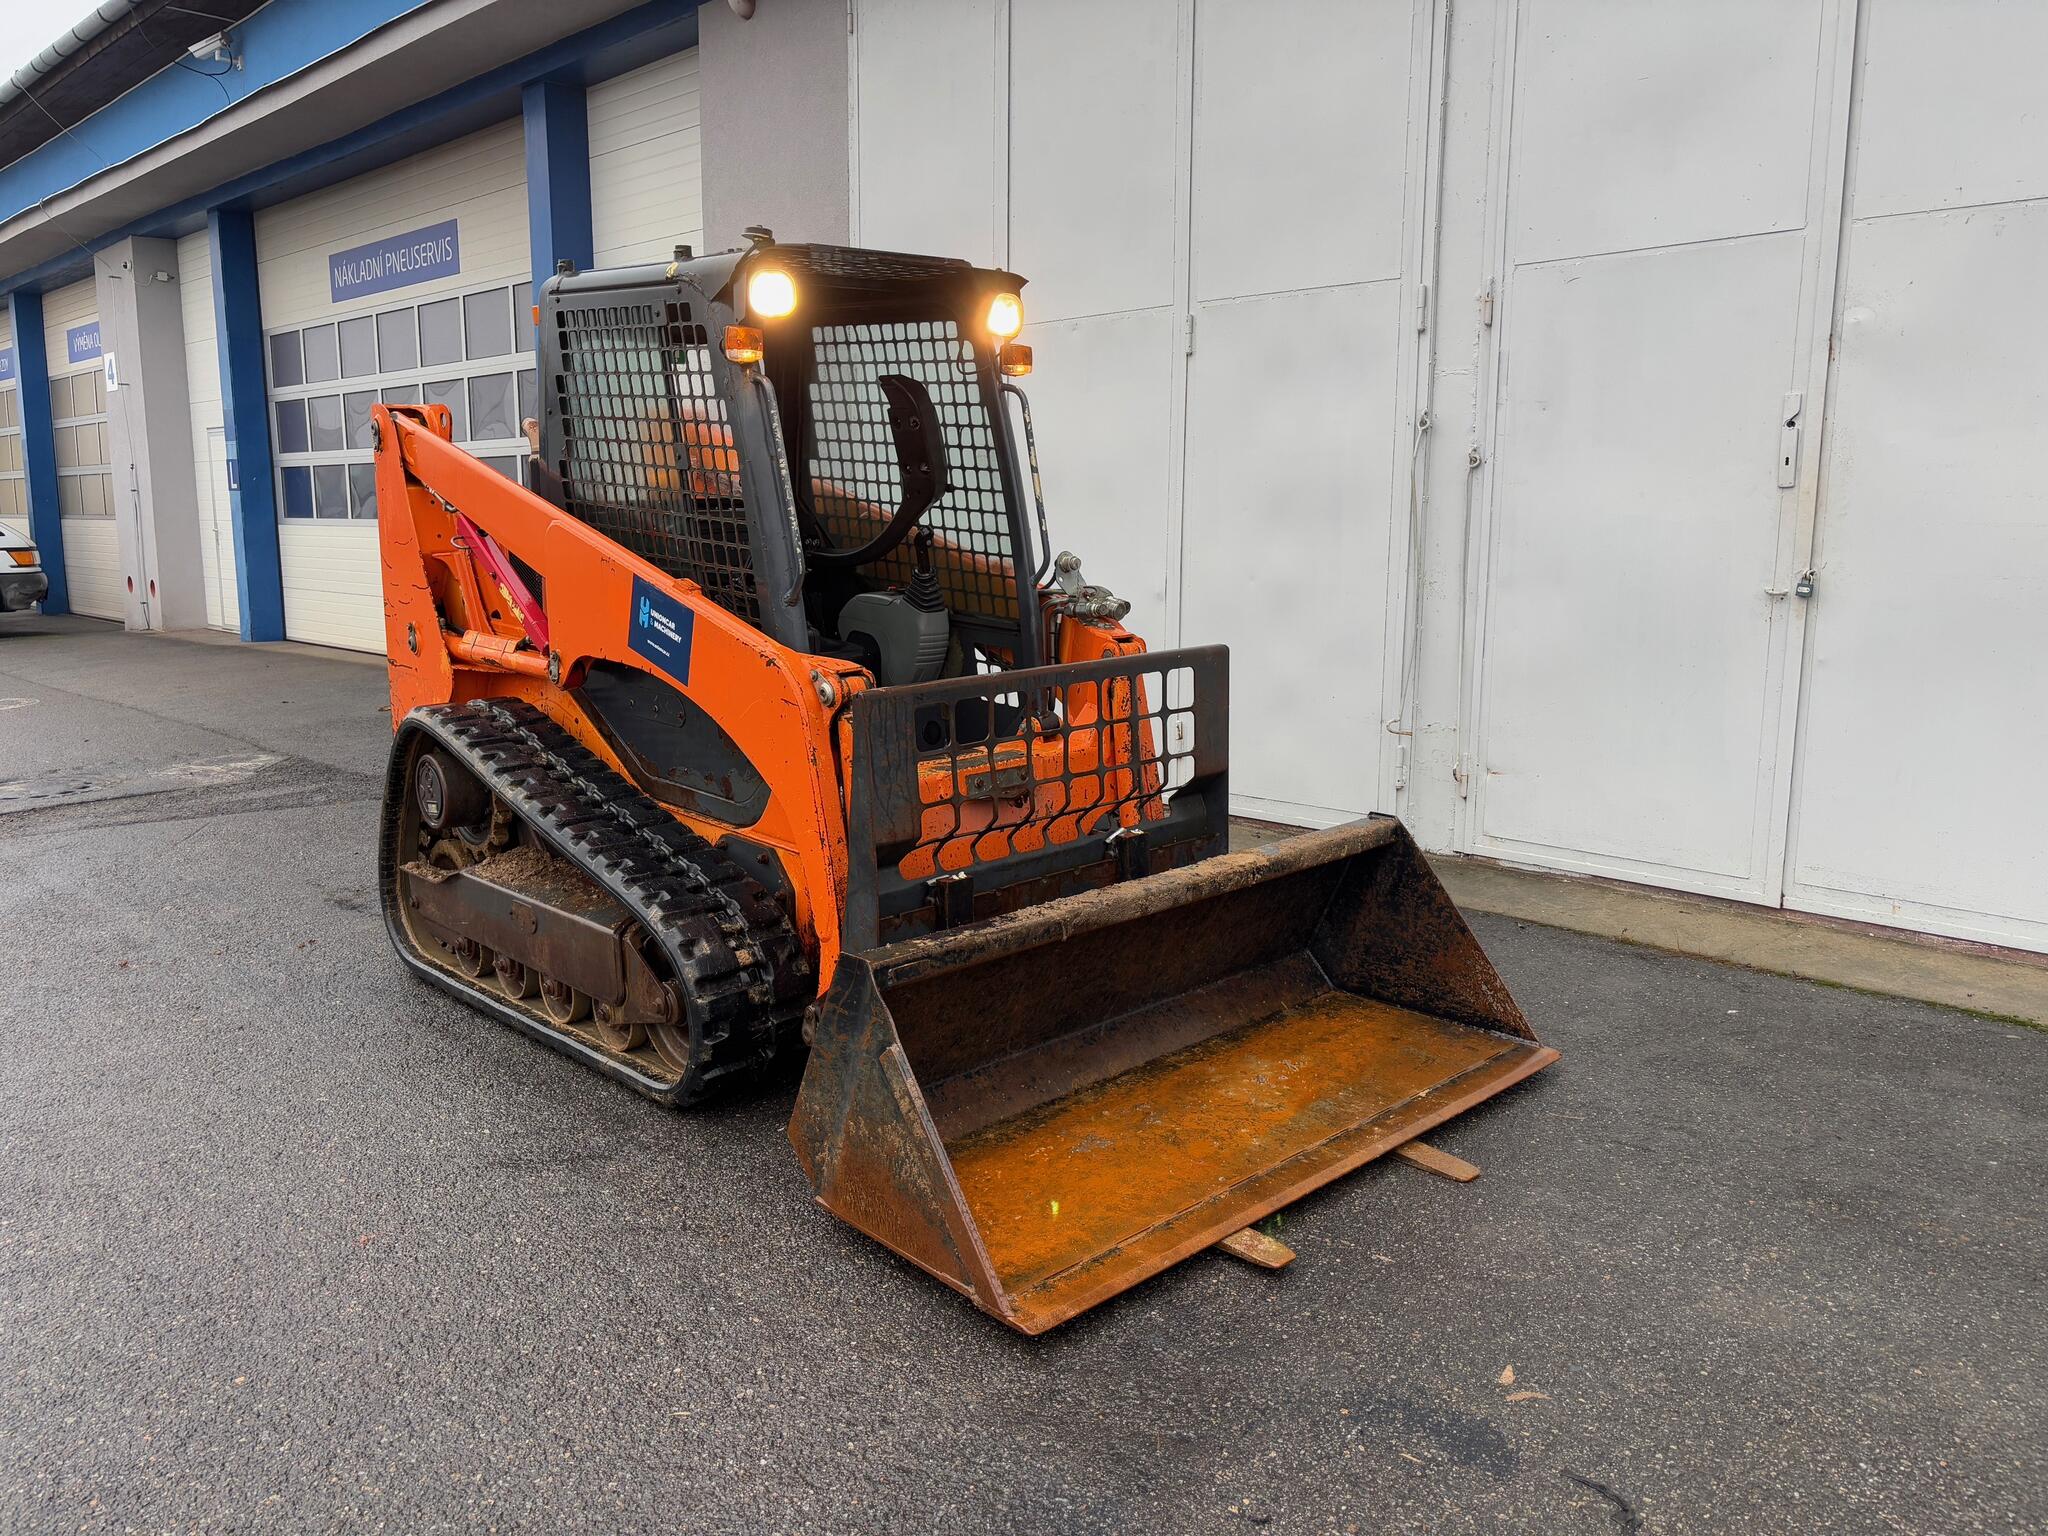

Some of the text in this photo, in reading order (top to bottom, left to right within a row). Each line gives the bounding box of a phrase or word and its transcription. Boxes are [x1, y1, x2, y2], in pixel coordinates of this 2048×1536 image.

[334, 236, 453, 288] NÁKLADNÍ PNEUSERVIS
[107, 358, 115, 385] 4
[654, 620, 682, 643] MACHINERY
